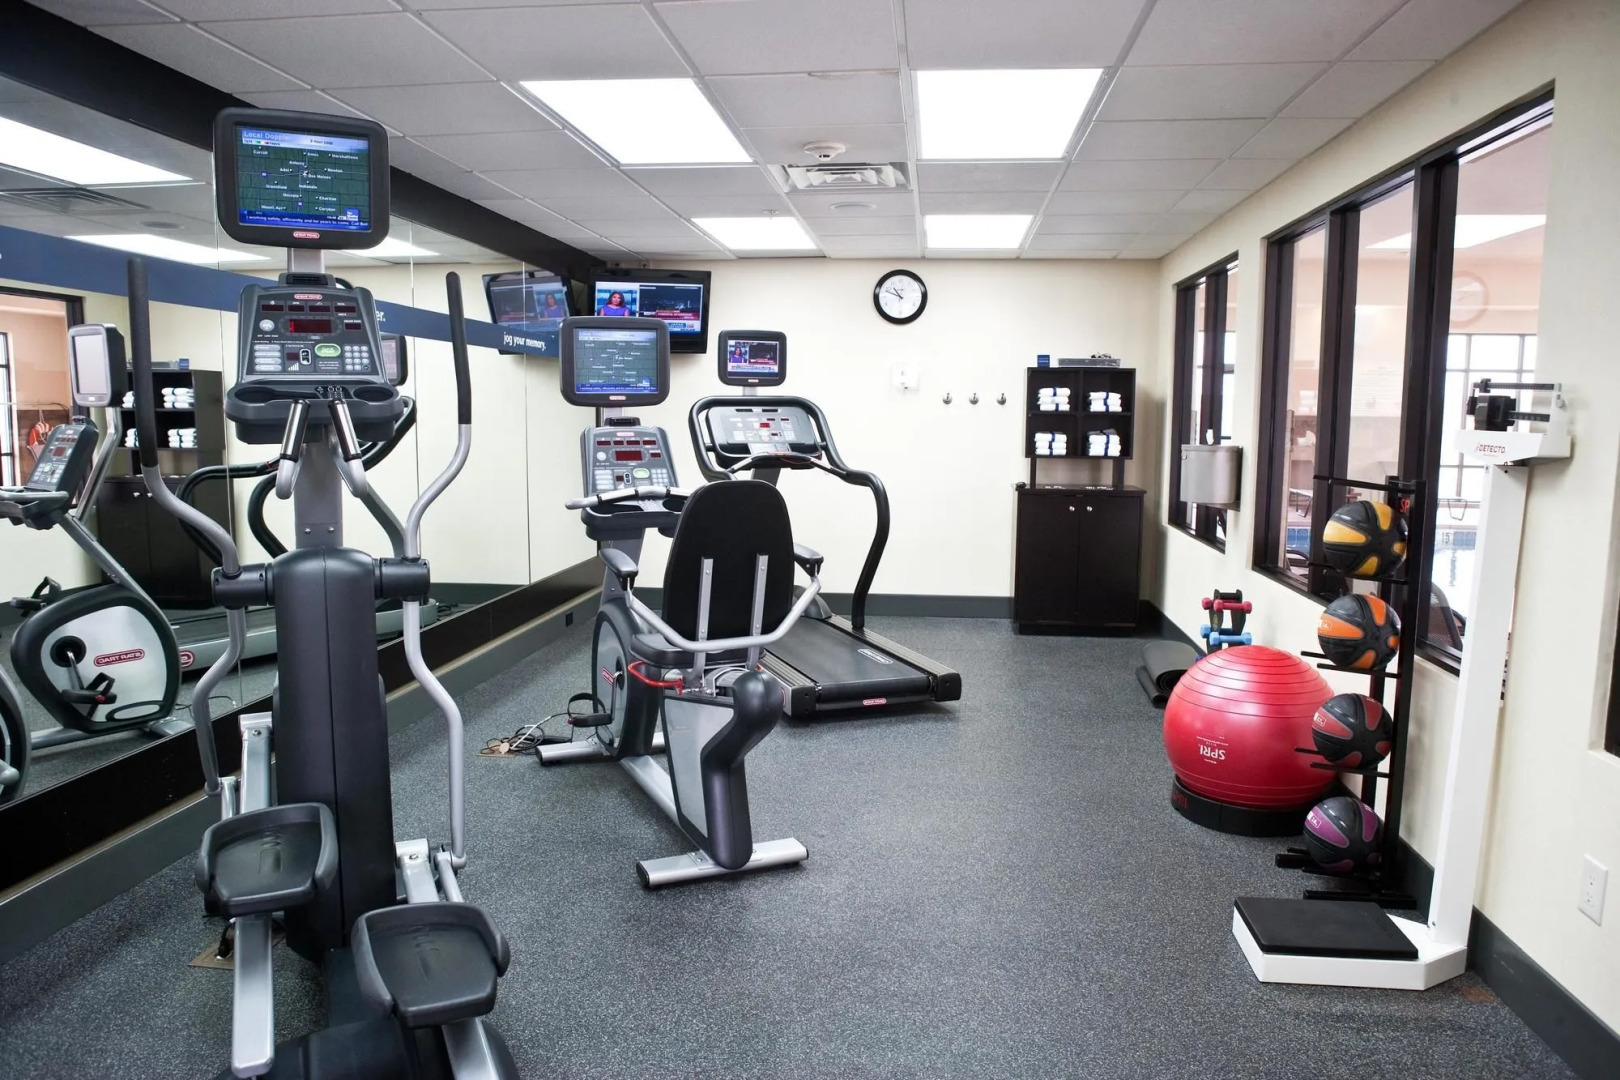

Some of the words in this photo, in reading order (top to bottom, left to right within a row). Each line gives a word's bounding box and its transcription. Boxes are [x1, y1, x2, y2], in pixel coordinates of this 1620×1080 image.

[243, 131, 263, 139] Local
[265, 132, 292, 141] Doppler
[503, 331, 513, 346] jog
[513, 336, 526, 347] your
[526, 338, 546, 351] memory.
[1478, 444, 1506, 454] DETECTO
[1400, 499, 1410, 512] SP
[1200, 745, 1226, 760] SPRI
